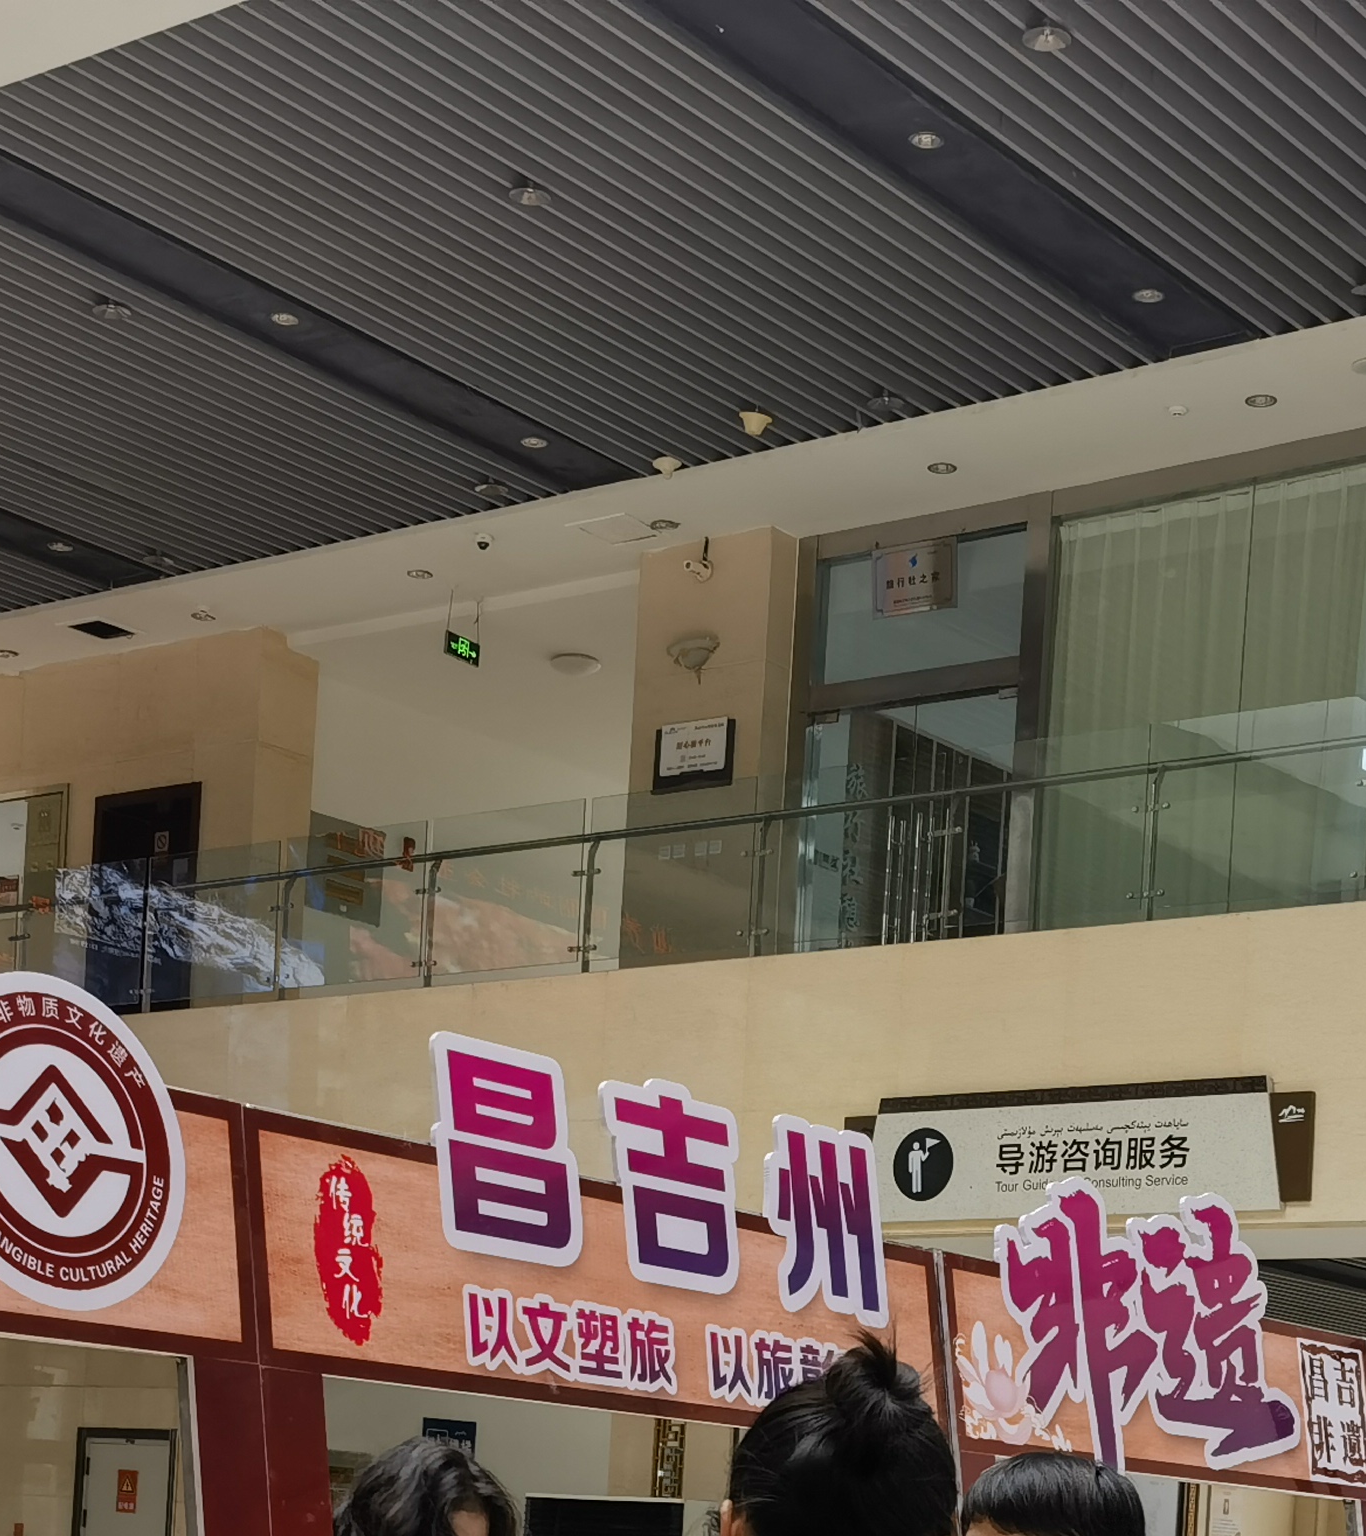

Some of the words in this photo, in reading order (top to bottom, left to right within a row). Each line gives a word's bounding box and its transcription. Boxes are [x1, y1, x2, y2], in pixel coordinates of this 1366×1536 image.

[443, 1044, 883, 1315] 昌吉州
[995, 1180, 1019, 1193] Tour
[1145, 1173, 1189, 1187] Service
[996, 1134, 1191, 1176] 导游咨询服务
[59, 1252, 133, 1283] CULTURAL
[130, 1174, 166, 1255] HERITAGE
[326, 1175, 368, 1322] 传统文化
[466, 1289, 675, 1388] 以文塑旅
[1005, 1188, 1297, 1468] 非遗
[1308, 1354, 1358, 1408] 昌吉
[1311, 1415, 1364, 1466] 非遗
